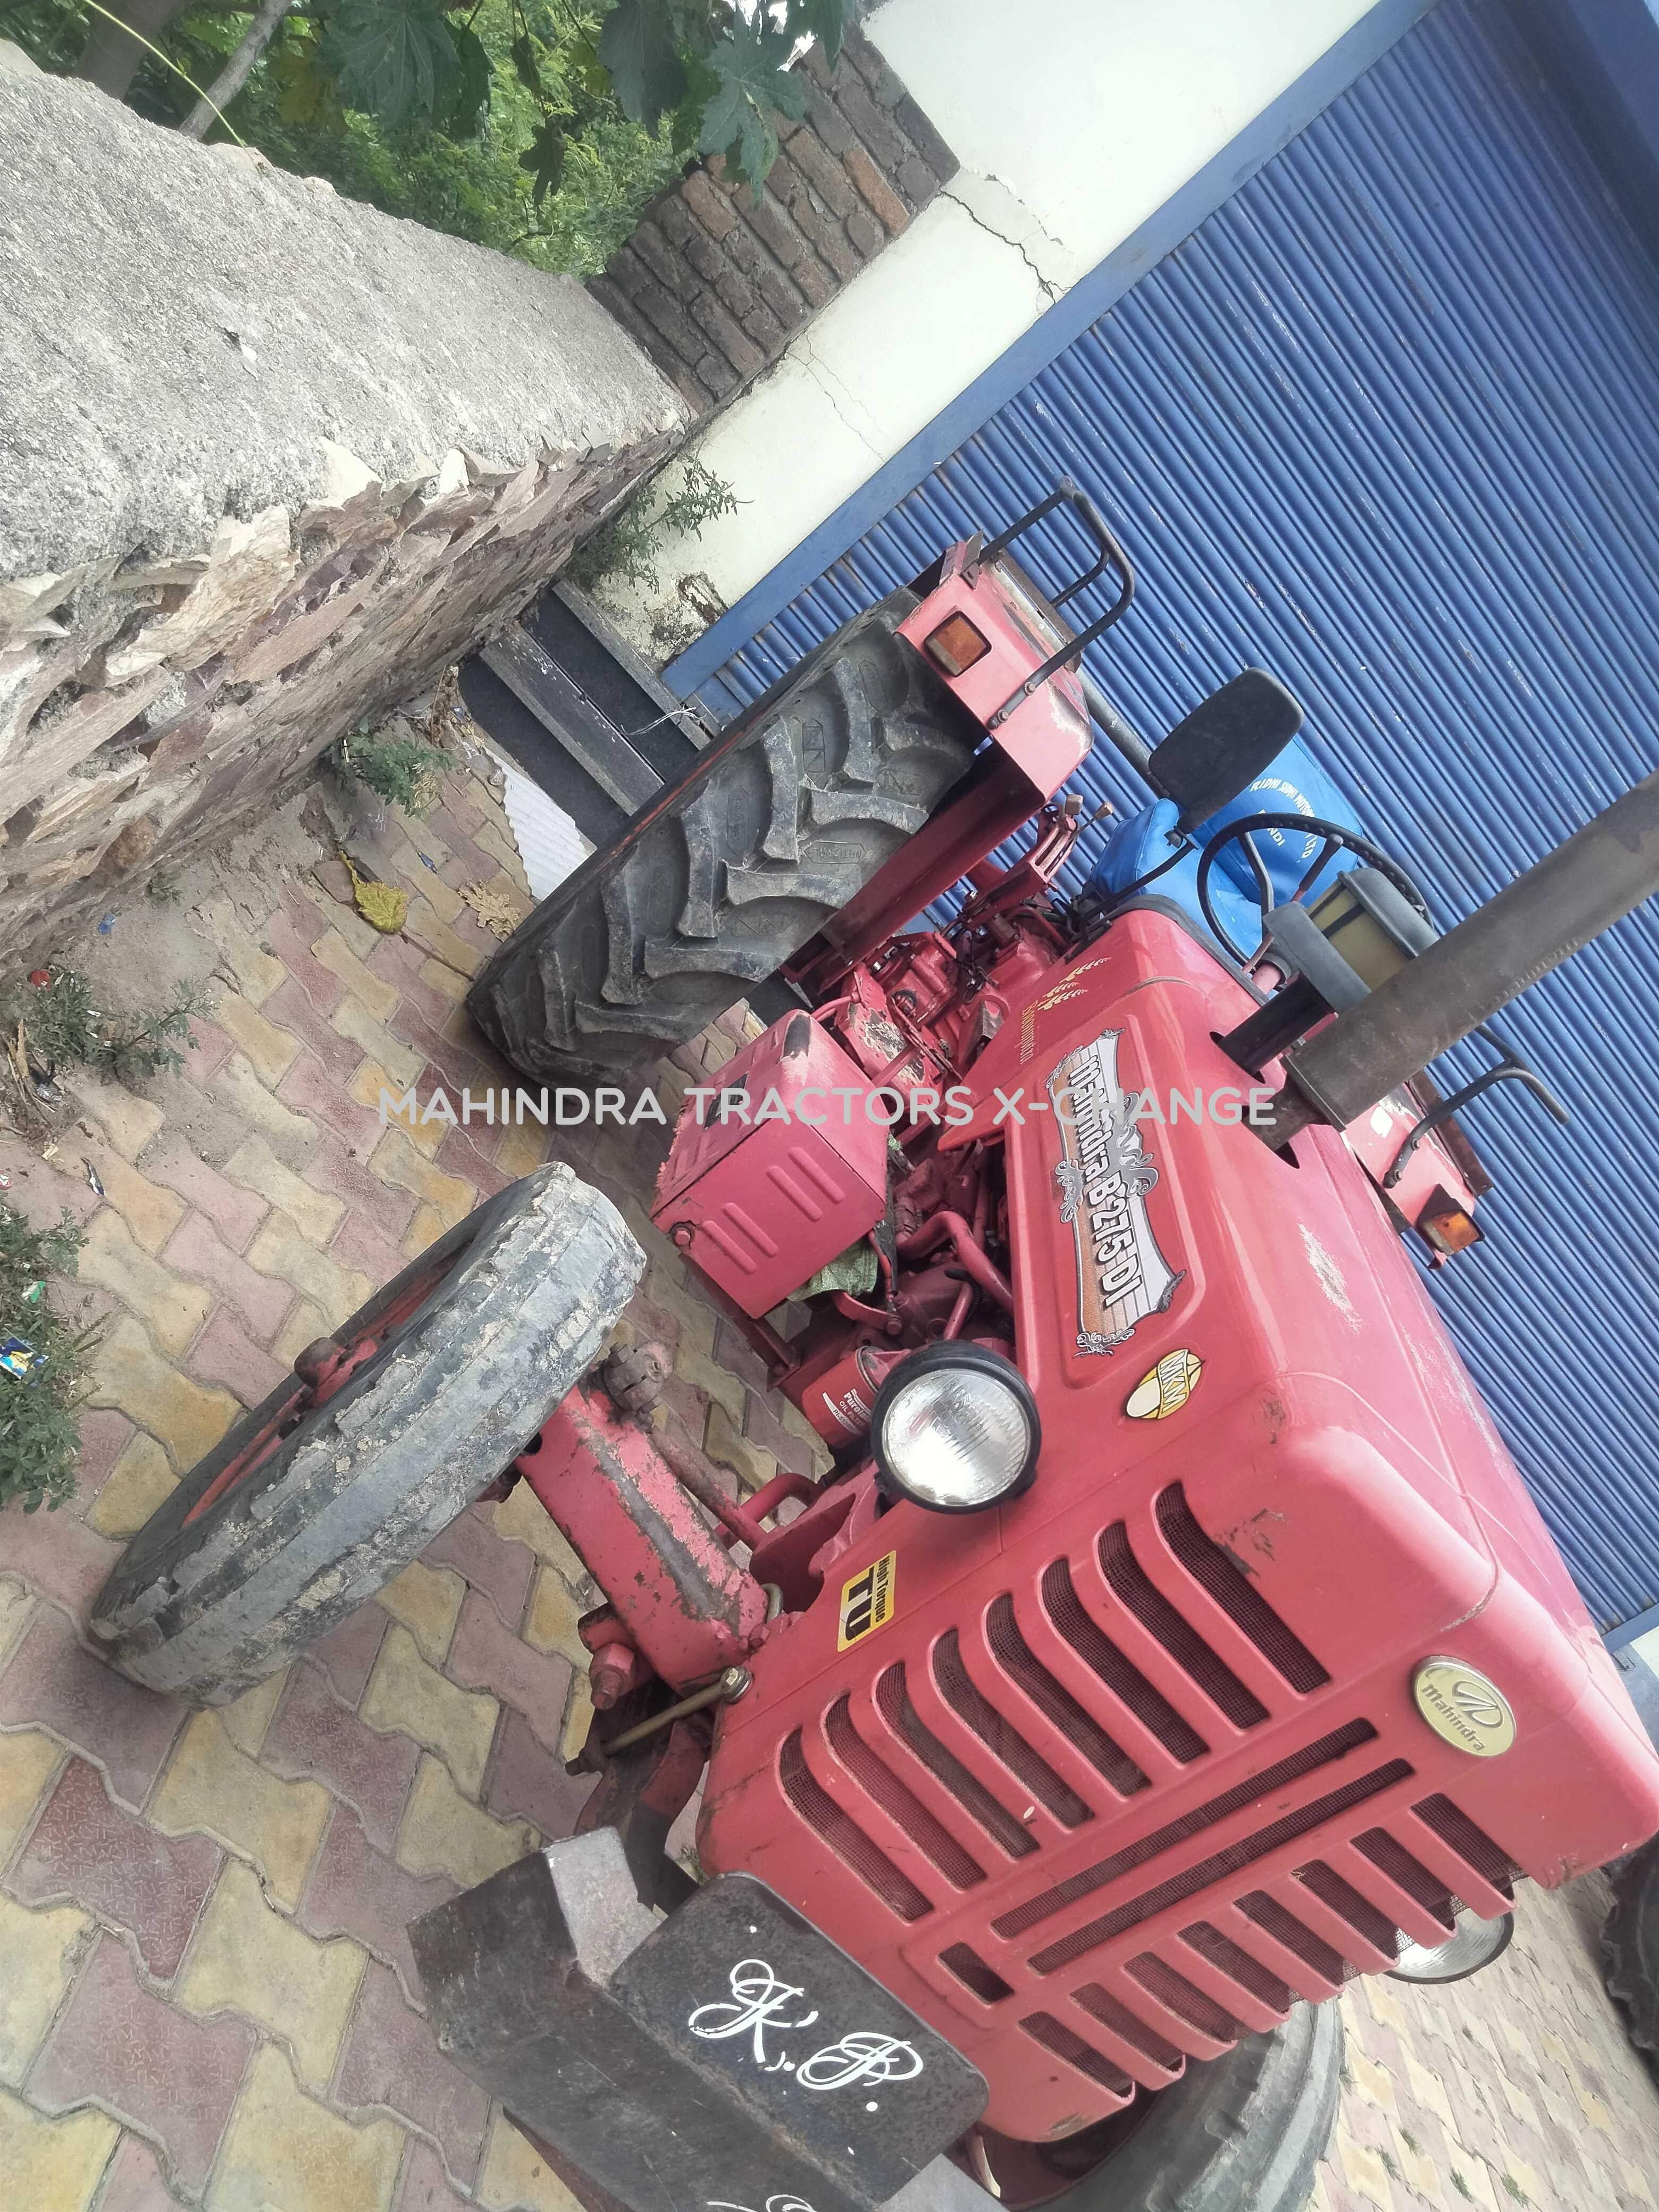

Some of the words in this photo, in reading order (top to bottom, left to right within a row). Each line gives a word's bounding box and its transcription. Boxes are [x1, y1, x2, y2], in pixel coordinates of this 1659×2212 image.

[1250, 778, 1281, 792] RIDHI
[1279, 781, 1298, 799] SIDHI
[1088, 1171, 1122, 1206] B
[1092, 1197, 1134, 1263] 275
[1101, 1253, 1143, 1307] DI
[1159, 1349, 1188, 1414] MKM
[840, 1401, 848, 1412] OIL
[876, 1555, 891, 1584] High
[875, 1579, 889, 1623] Torque
[1421, 1683, 1486, 1751] mahindra
